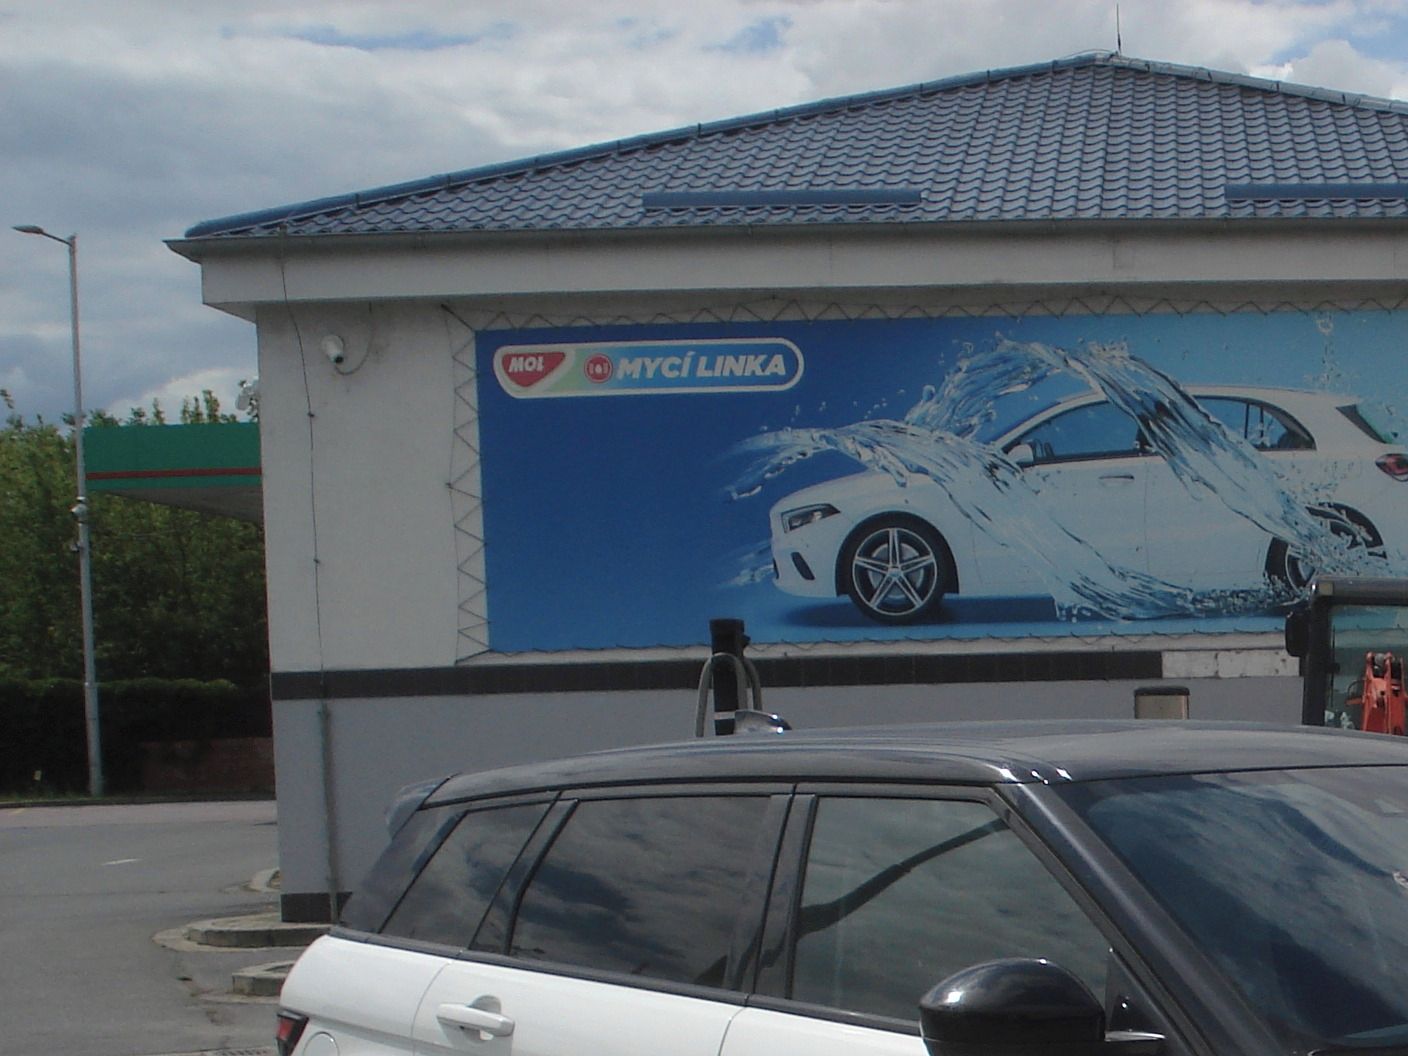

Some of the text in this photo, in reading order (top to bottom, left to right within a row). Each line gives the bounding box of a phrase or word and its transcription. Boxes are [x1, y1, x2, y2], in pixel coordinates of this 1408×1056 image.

[508, 357, 545, 373] MOL
[616, 352, 787, 380] MYCÍ LINKA
